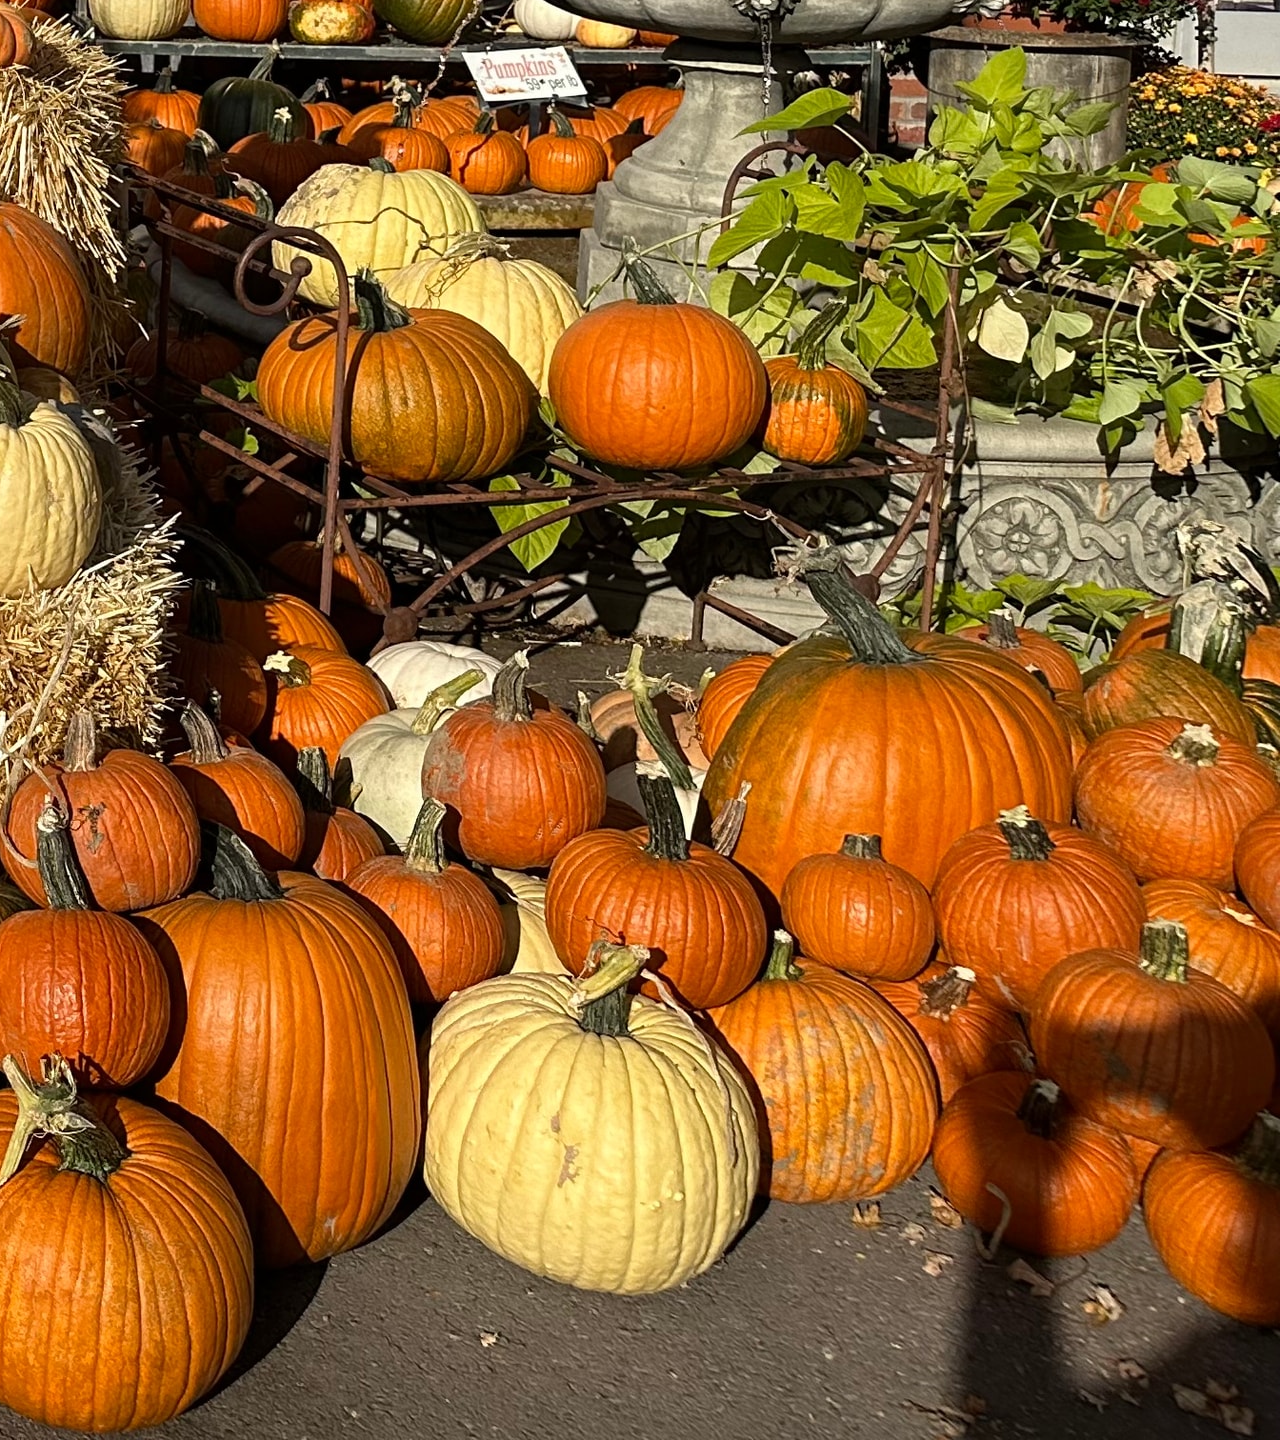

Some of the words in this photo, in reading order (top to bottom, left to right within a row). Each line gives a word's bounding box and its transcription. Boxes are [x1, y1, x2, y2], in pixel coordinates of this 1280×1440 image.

[483, 54, 557, 82] Pumpkins
[549, 77, 566, 90] per
[568, 74, 579, 87] lb
